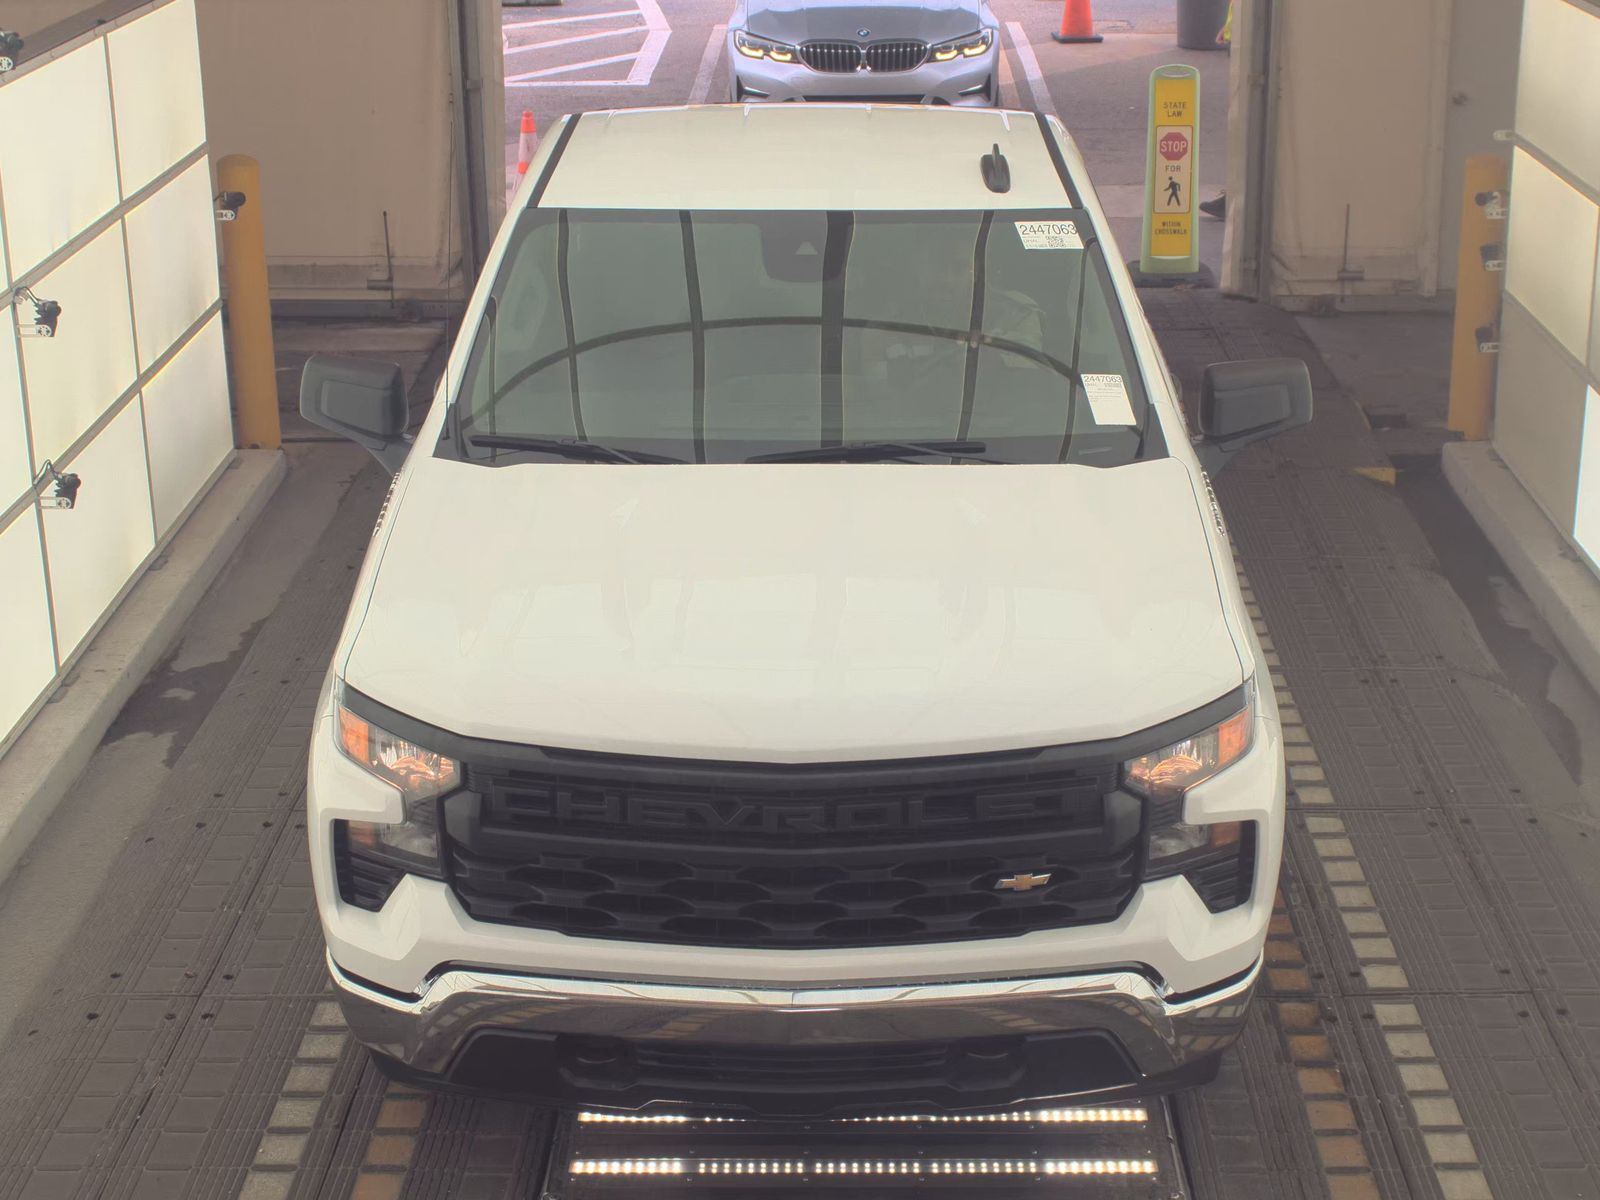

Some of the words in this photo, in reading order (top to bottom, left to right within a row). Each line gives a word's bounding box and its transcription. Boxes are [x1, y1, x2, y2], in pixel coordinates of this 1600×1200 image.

[1162, 101, 1188, 109] STATE
[1167, 110, 1183, 118] LAW
[1160, 140, 1187, 152] STOP
[1165, 164, 1181, 172] FOR
[1019, 224, 1078, 235] 2447063
